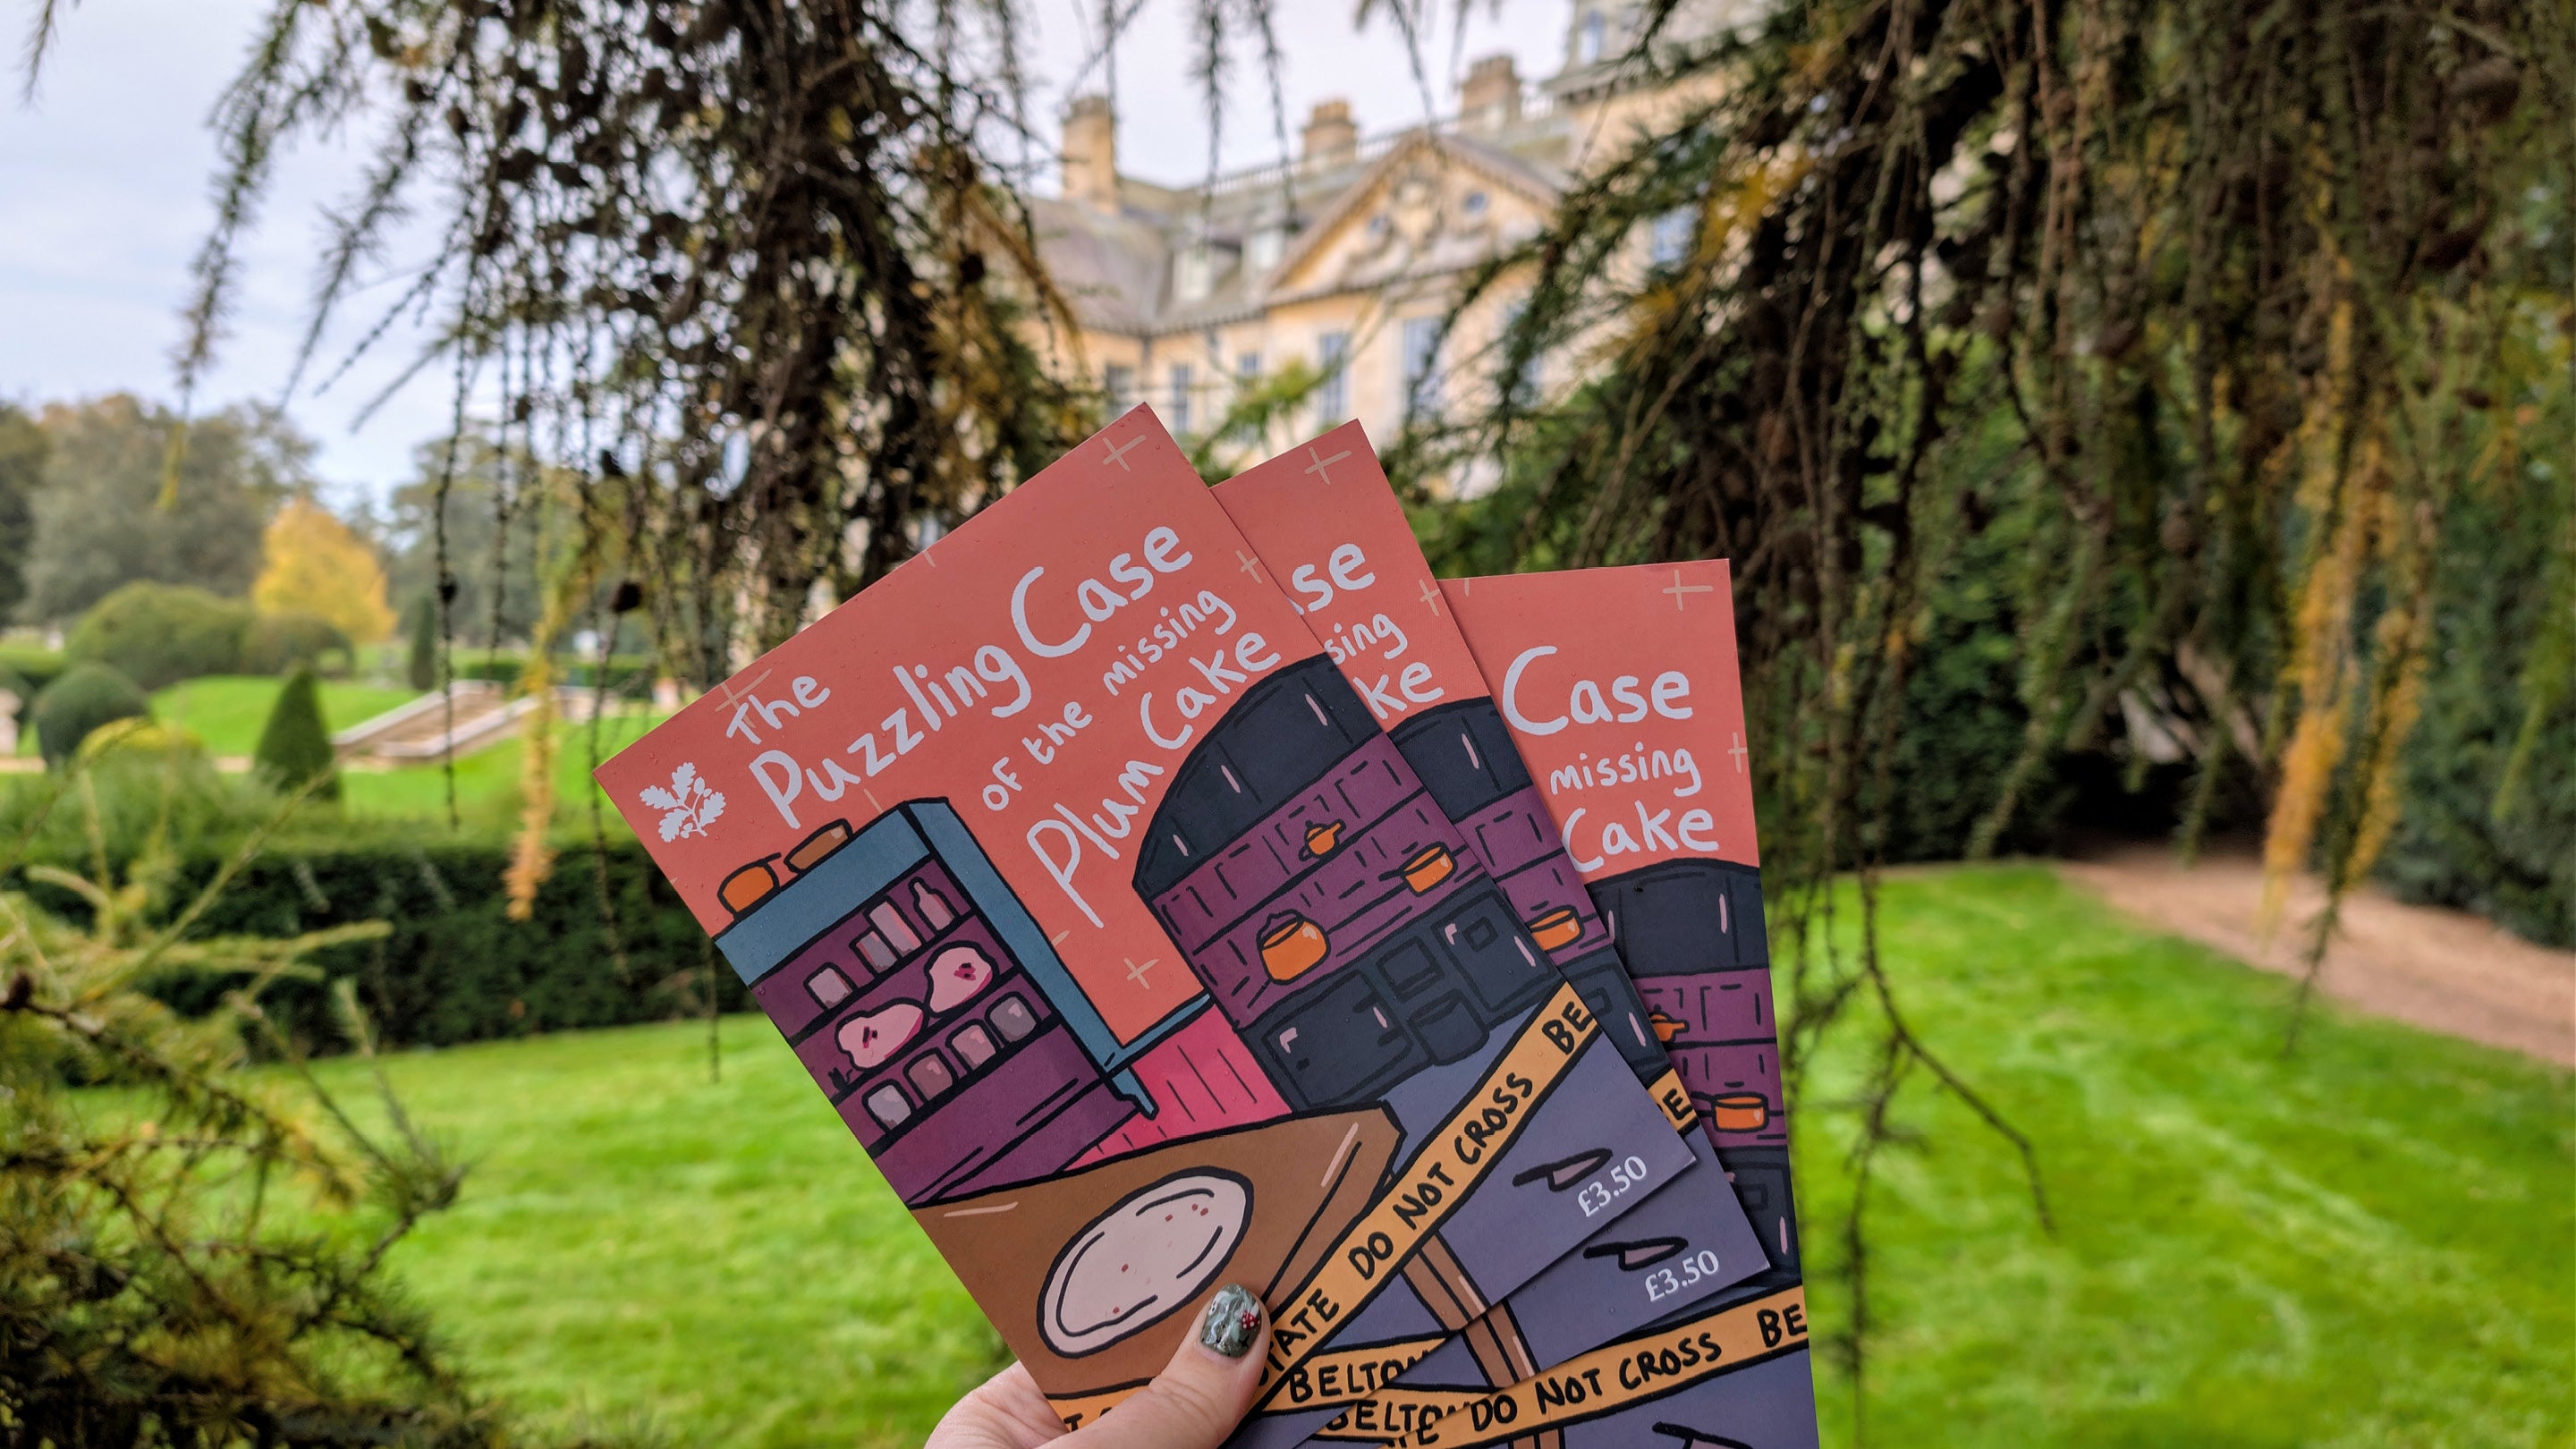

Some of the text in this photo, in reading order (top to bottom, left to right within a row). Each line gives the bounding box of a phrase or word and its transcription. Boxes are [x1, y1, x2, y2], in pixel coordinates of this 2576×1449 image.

[726, 675, 830, 744] The
[749, 526, 1192, 829] Puzzling Case
[1021, 701, 1092, 765] the
[1103, 590, 1236, 695] missing
[1503, 645, 1693, 736] Case
[1026, 632, 1281, 928] Plum Cake
[1550, 741, 1701, 797] missing
[1562, 801, 1719, 873] Cake
[1657, 1089, 1694, 1122] E
[1258, 1001, 1592, 1385] TATE DO NOT CROSS BE
[1577, 1155, 1648, 1217] £3.50
[1644, 1250, 1720, 1302] £3.50
[1289, 1351, 1430, 1402] BELTO
[1471, 1304, 1808, 1432] DO NOT CROSS BE
[1326, 1399, 1472, 1432] ELTO
